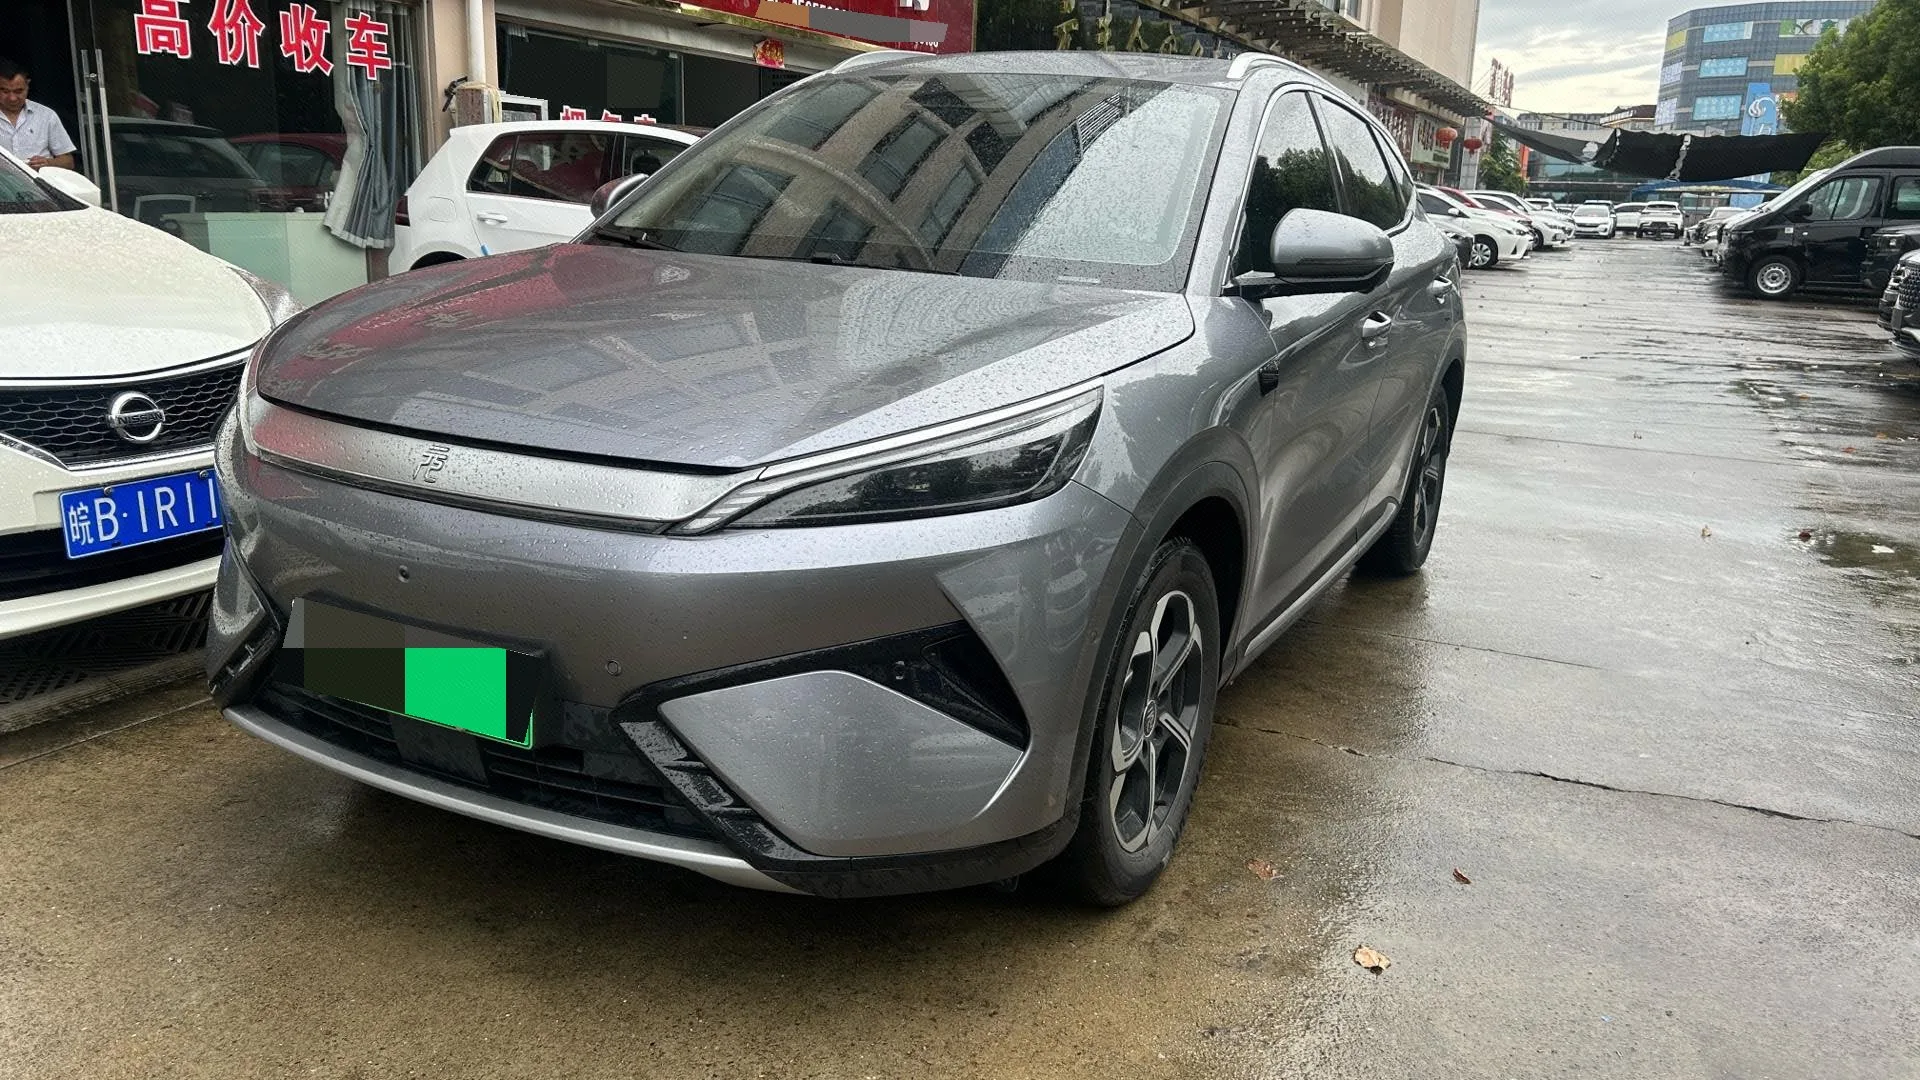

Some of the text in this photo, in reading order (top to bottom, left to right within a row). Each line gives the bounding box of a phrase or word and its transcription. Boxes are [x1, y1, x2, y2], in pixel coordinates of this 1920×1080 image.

[134, 0, 392, 80] 高价收车
[117, 412, 163, 426] NISSAN
